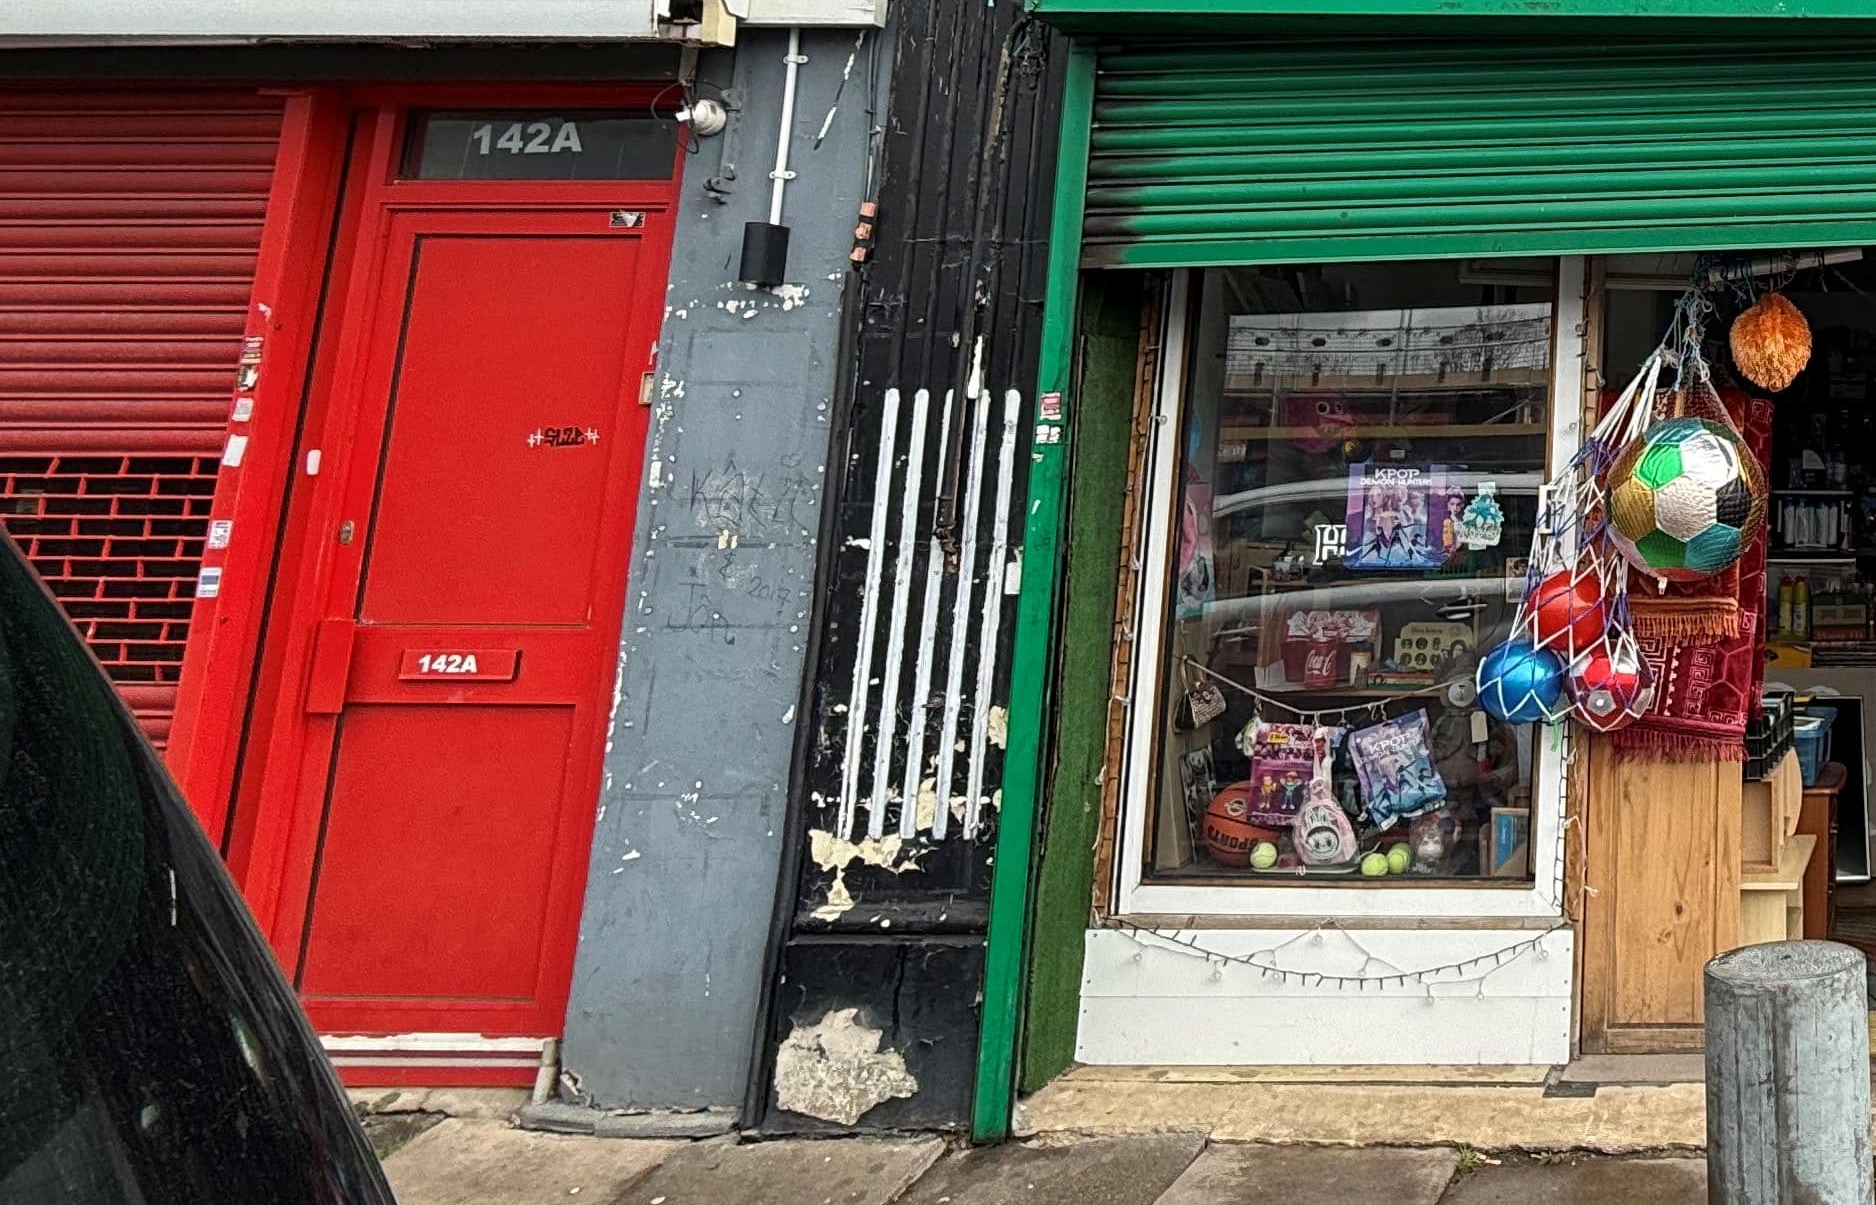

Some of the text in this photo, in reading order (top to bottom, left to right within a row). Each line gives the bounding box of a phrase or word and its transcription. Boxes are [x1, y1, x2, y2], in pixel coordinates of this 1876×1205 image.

[472, 122, 583, 155] 142A
[1374, 467, 1421, 479] KPOP
[418, 655, 478, 675] 142A
